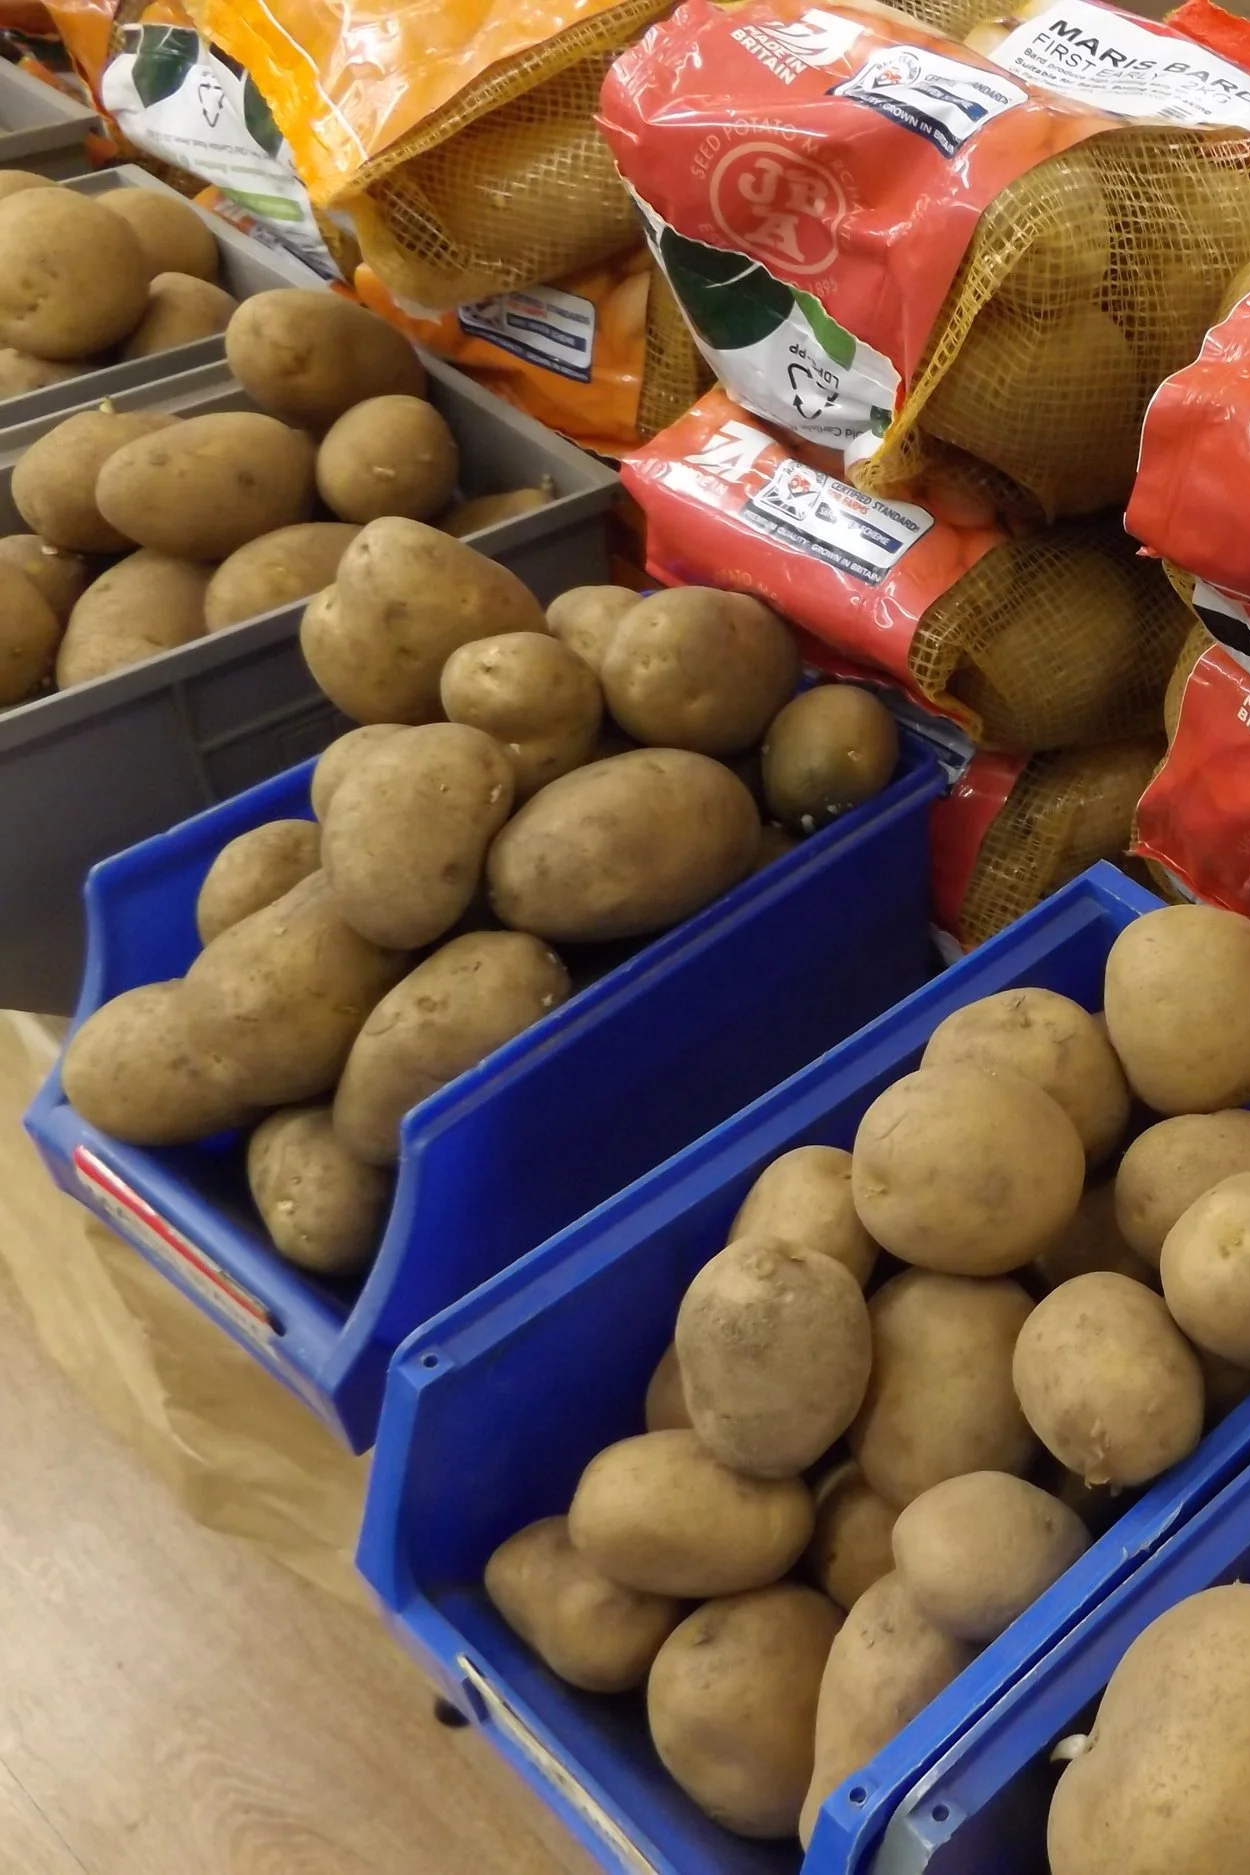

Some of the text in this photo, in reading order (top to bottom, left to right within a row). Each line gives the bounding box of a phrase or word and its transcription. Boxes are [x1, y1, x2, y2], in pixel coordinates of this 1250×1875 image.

[730, 28, 796, 86] BRITAIN
[742, 25, 807, 73] MADE IN
[1024, 47, 1048, 65] Bard
[1032, 33, 1096, 72] FIRST
[1049, 20, 1157, 70] MARIS
[1015, 57, 1057, 80] Suitable
[883, 103, 932, 134] GROWN IN
[691, 135, 720, 180] SEED
[722, 117, 797, 142] POTATO
[830, 481, 873, 507] CERTIFIED
[777, 525, 810, 548] QUALITY
[810, 543, 841, 565] GROWN
[840, 556, 851, 569] IN
[850, 561, 882, 584] BRITAIN
